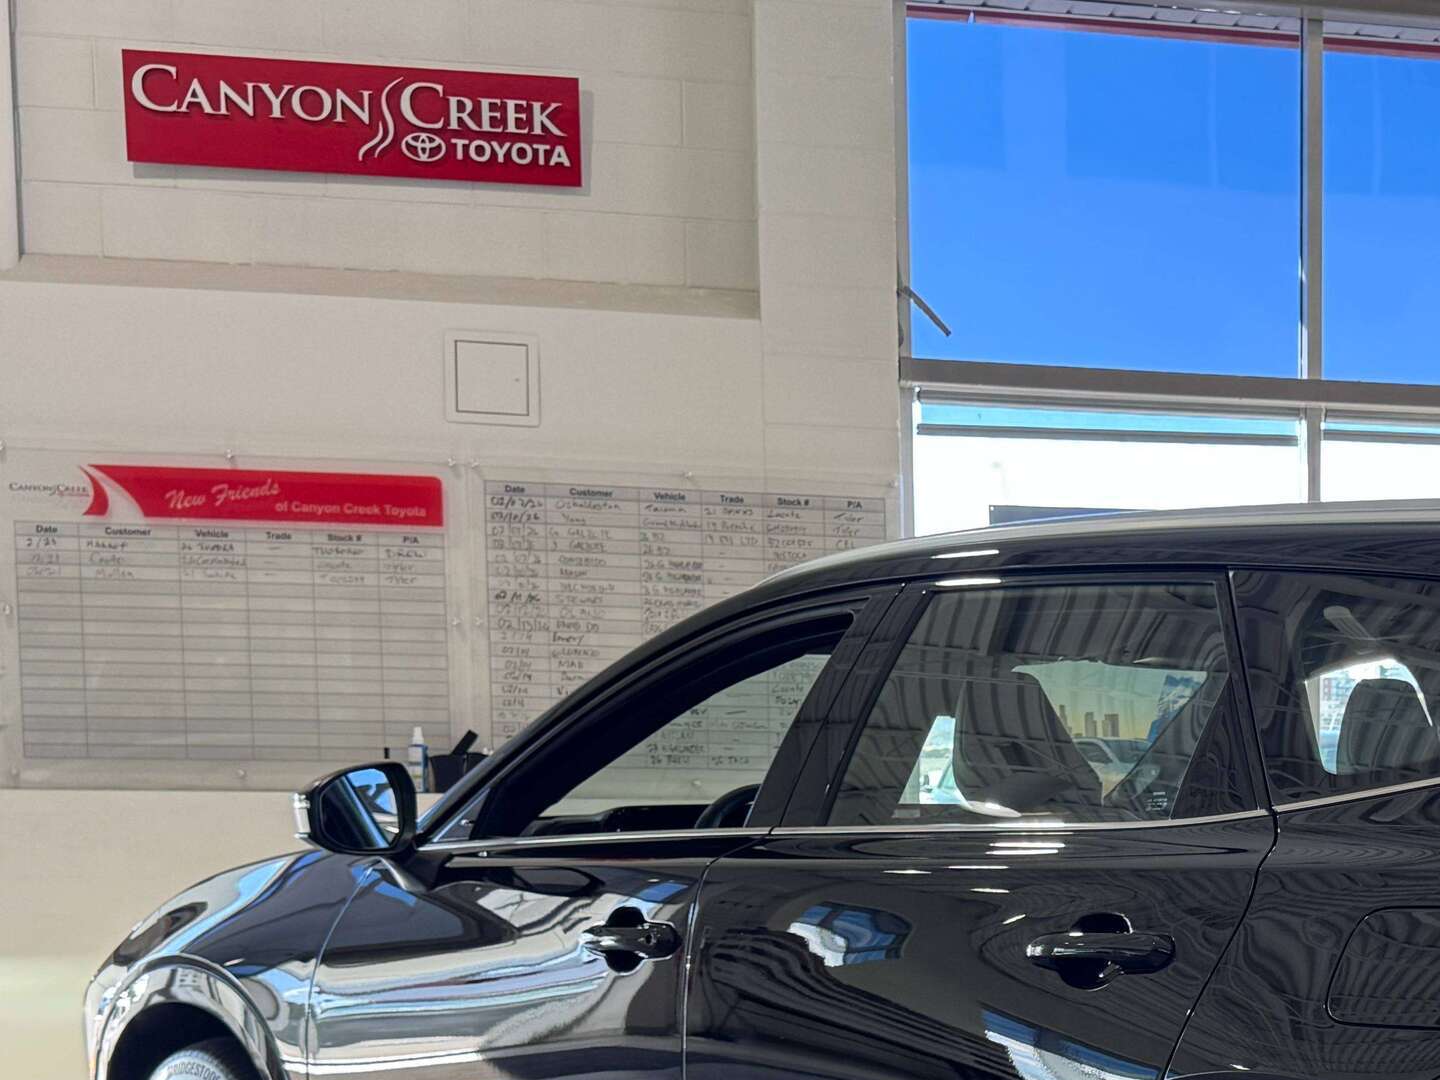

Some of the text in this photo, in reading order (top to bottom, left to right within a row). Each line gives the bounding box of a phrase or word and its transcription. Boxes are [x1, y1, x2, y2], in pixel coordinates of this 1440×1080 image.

[131, 63, 568, 137] CANYON CREEK
[452, 137, 571, 167] TOYOTA
[164, 478, 280, 510] New Friends
[505, 485, 526, 494] Date
[569, 487, 614, 498] Customer
[653, 492, 686, 502] Vehicle
[720, 494, 744, 504] Trade
[777, 497, 802, 506] Stock
[275, 501, 427, 518] of Canyon Creek Toyota
[36, 525, 58, 534] Date
[104, 526, 152, 537] Customer
[194, 529, 229, 539] Vehicle
[266, 532, 292, 541] Trade
